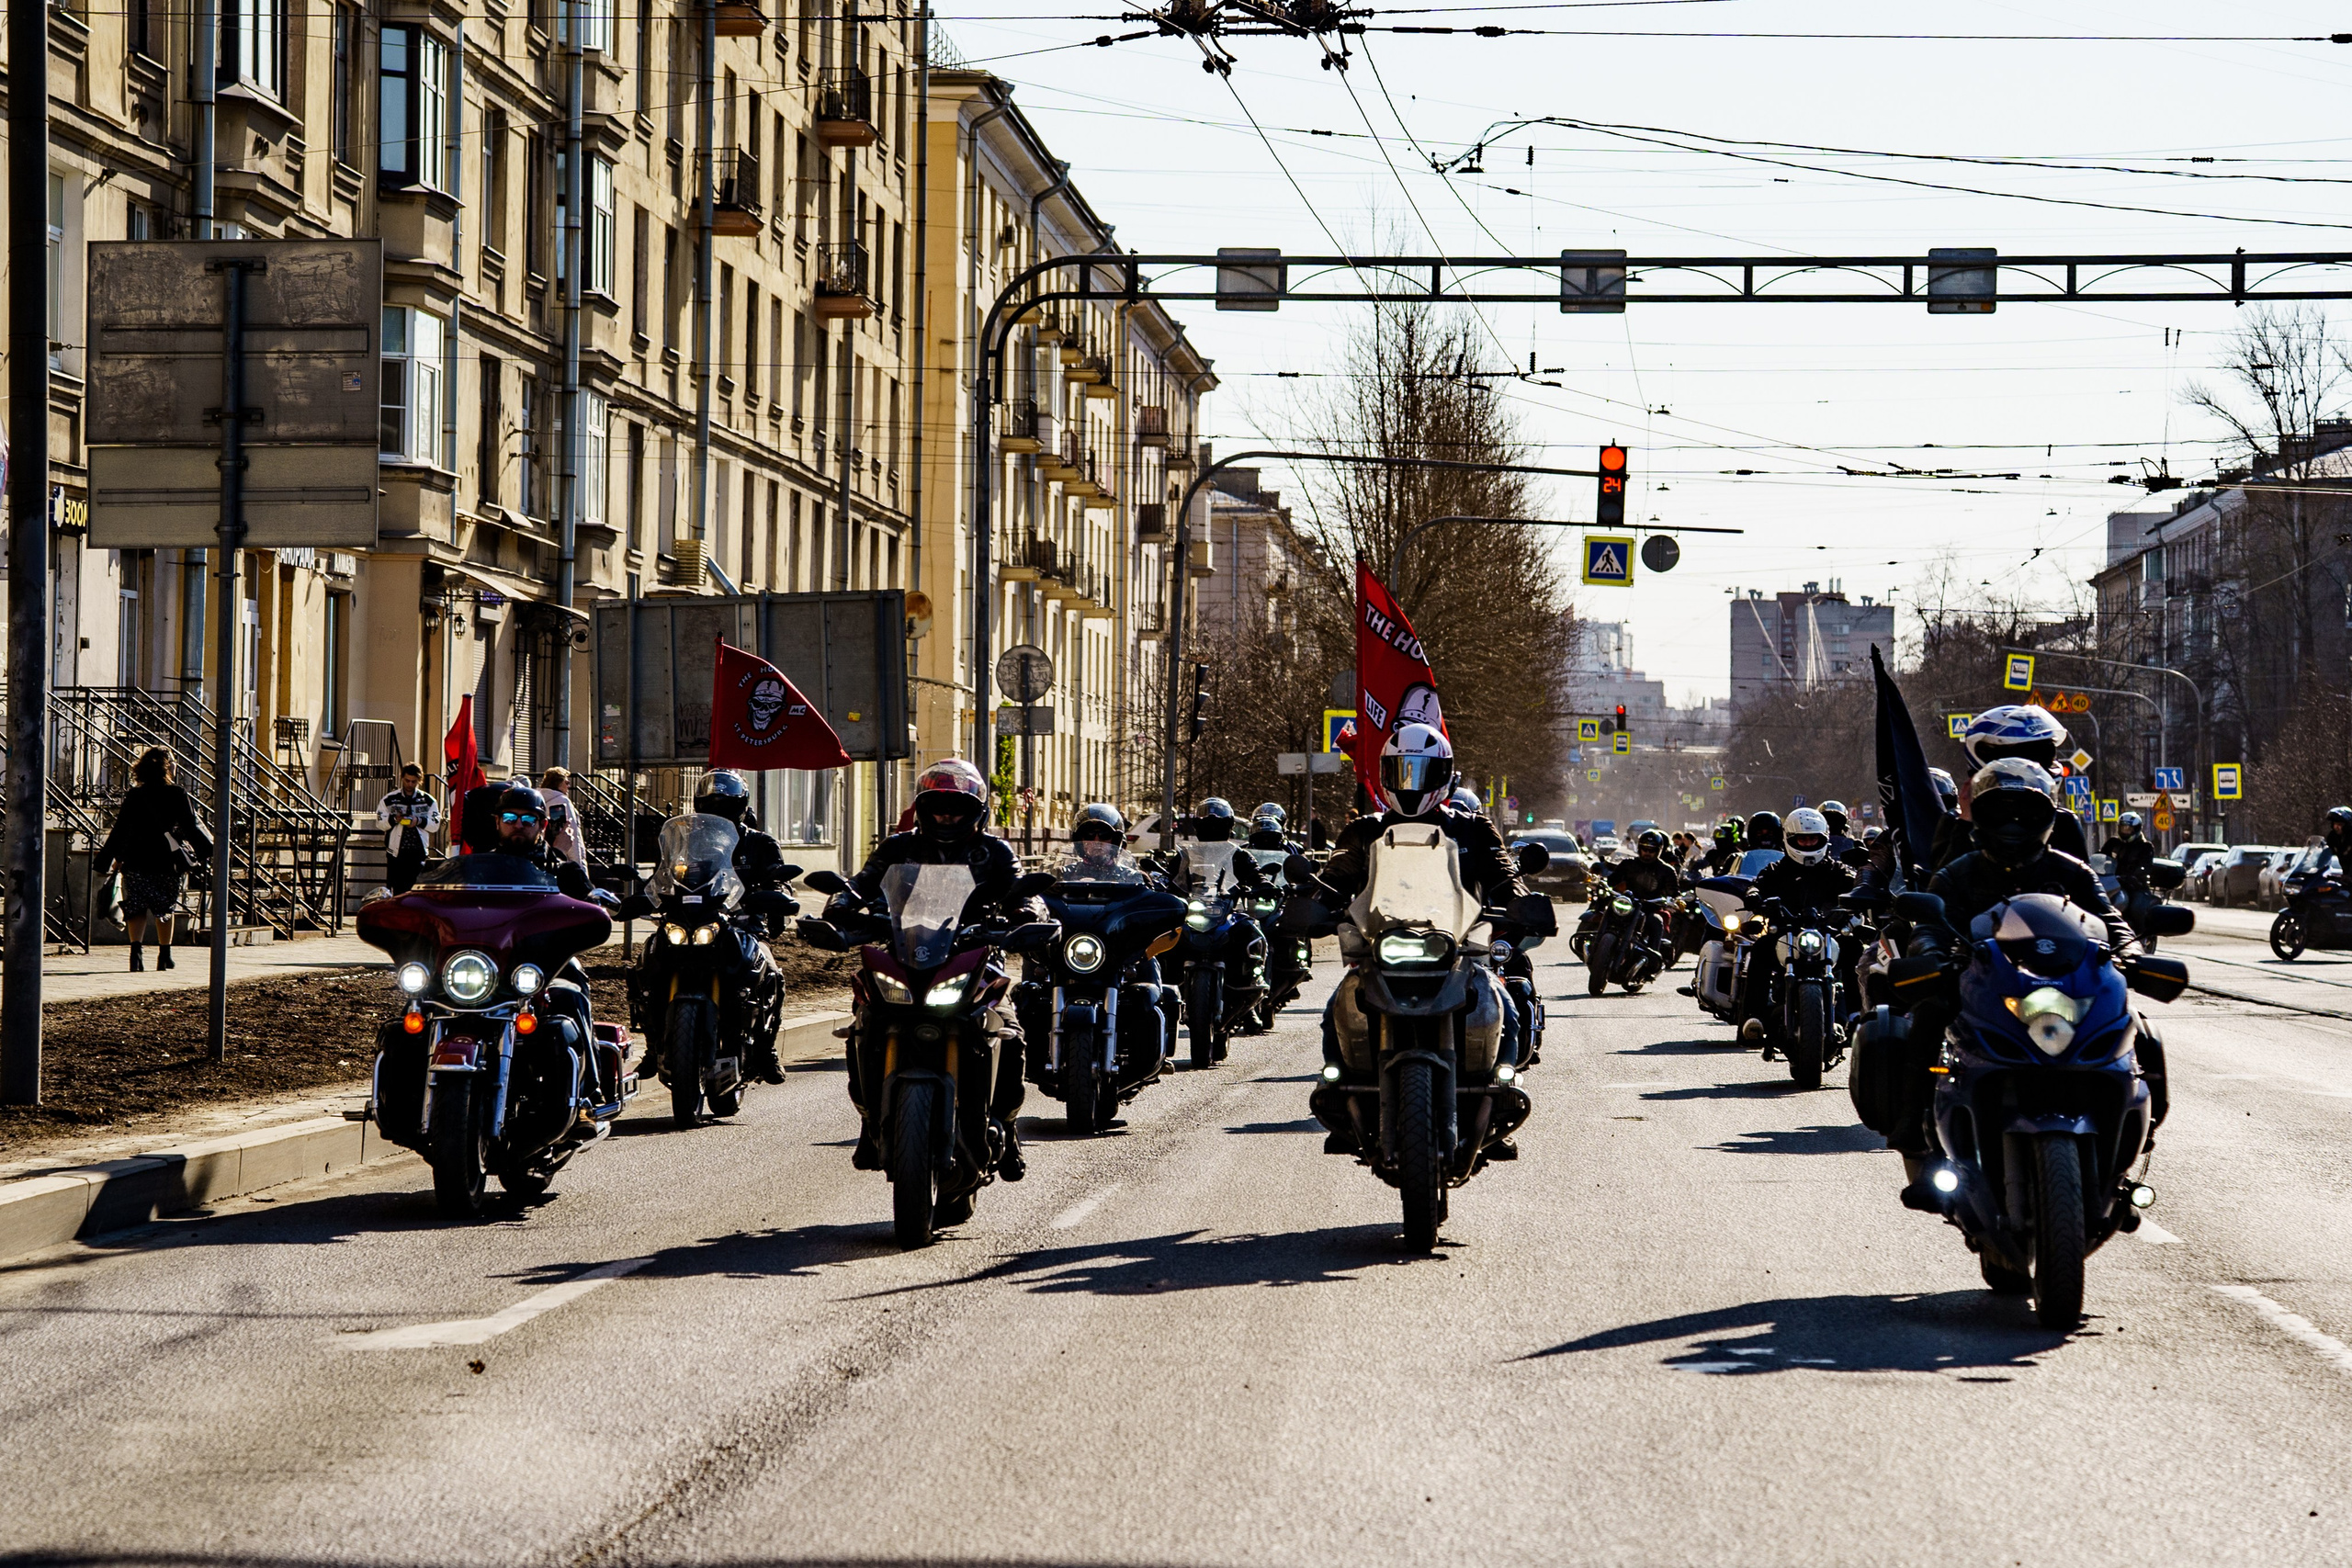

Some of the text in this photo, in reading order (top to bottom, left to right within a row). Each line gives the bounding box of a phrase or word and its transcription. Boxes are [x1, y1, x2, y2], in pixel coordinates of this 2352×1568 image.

[1603, 477, 1622, 492] 24
[279, 547, 315, 570] АНОРАМА
[1365, 603, 1430, 667] THE HO
[738, 671, 752, 688] THE
[790, 706, 806, 715] MC
[1366, 694, 1384, 724] LIFE
[2074, 698, 2086, 707] 40
[2158, 816, 2172, 826] 40
